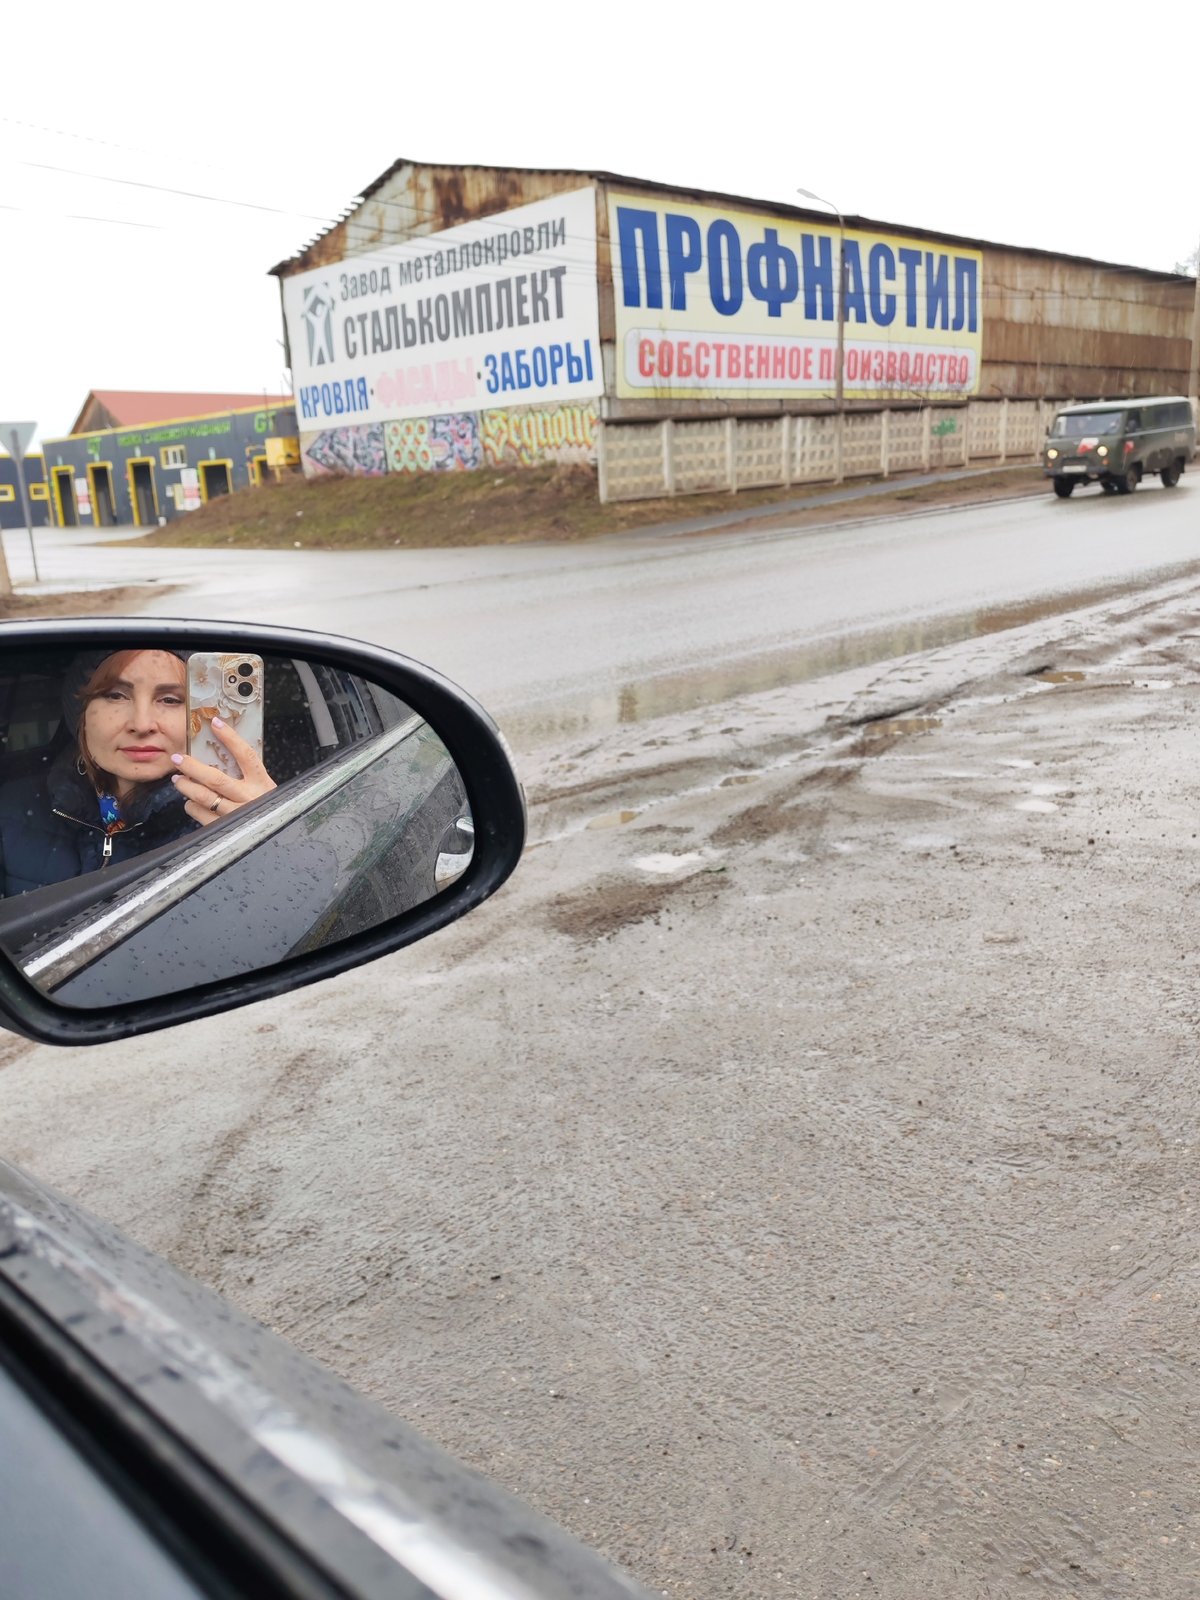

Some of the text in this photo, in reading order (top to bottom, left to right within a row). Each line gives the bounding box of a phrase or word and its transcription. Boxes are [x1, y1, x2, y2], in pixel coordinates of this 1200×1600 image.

[339, 217, 566, 302] Завод металлокровли
[617, 206, 978, 333] ПРОФНАСТИЛ
[343, 265, 567, 360] СТАЛЬКОМПЛЕКТ
[300, 376, 369, 418] КРОВЛЯ
[484, 339, 594, 394] ЗАБОРЫ
[638, 338, 970, 386] СОБСТВЕННОЕ ПОИЗВОДСТВО
